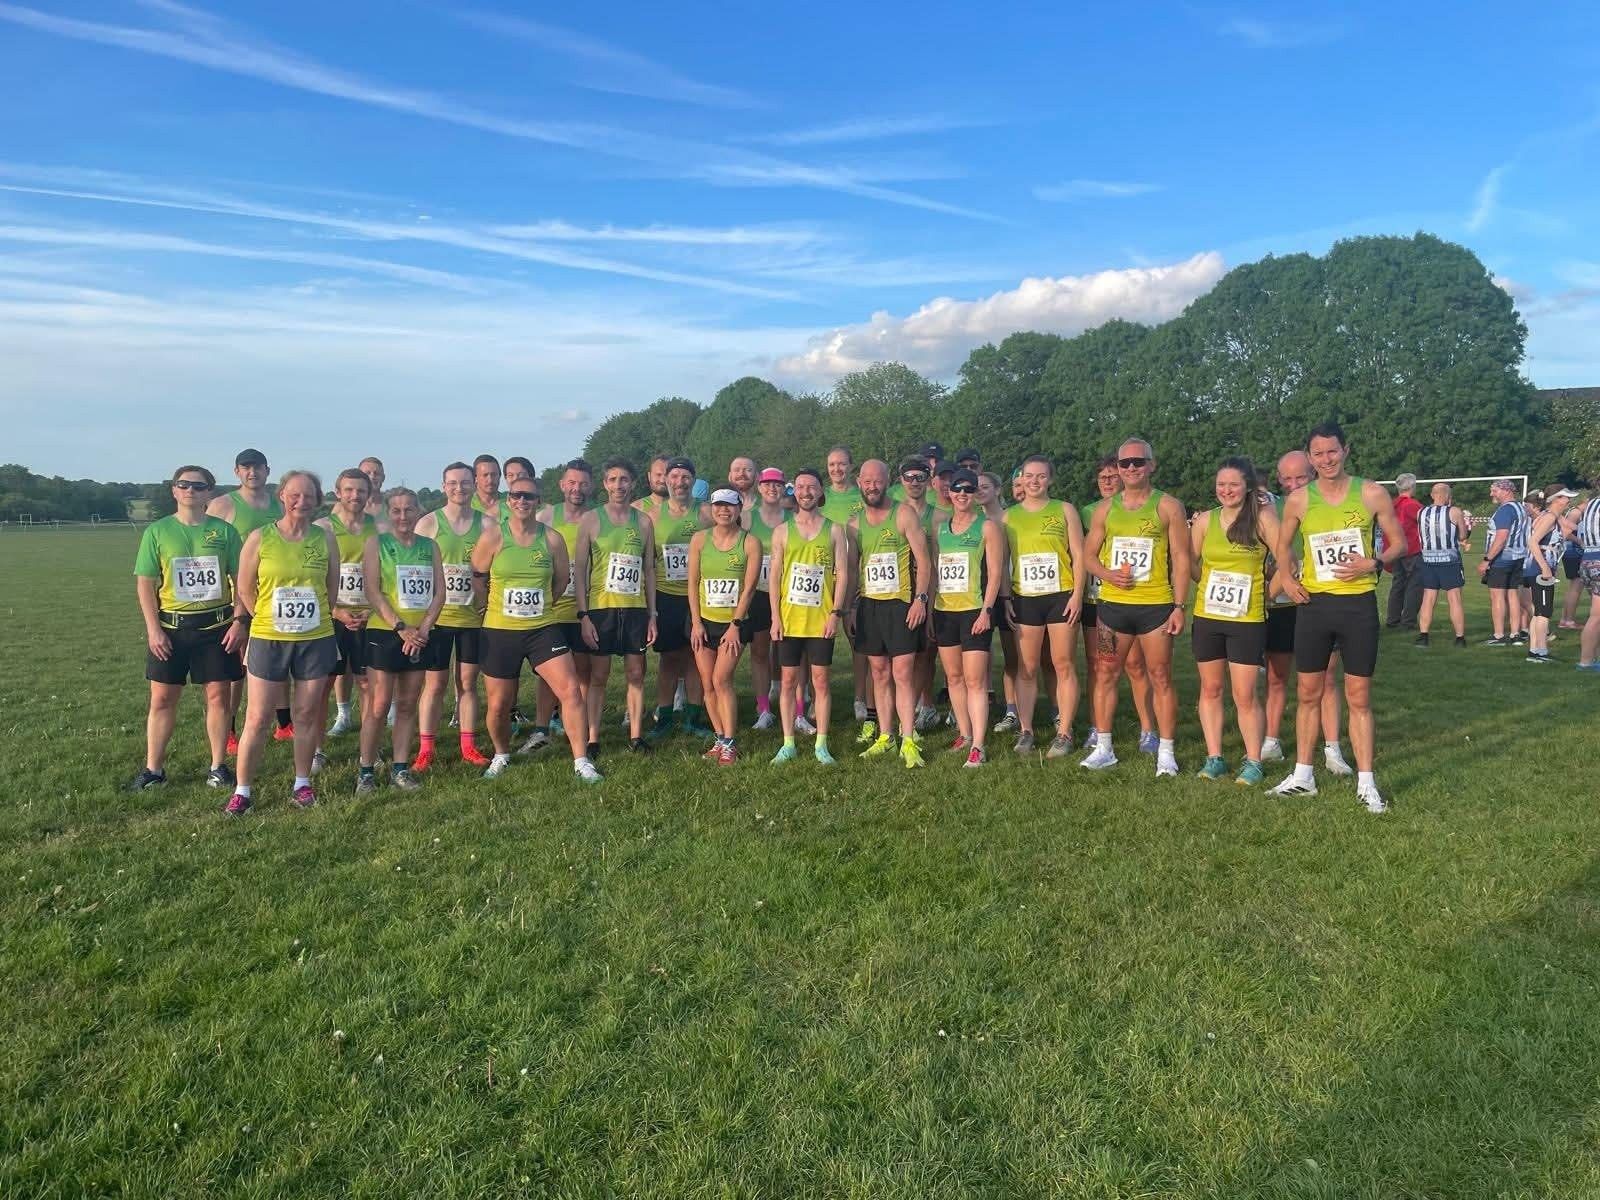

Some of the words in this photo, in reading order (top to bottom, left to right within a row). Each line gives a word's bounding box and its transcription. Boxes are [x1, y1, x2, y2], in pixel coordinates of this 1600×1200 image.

[667, 555, 688, 569] 134
[1115, 550, 1148, 568] 1352
[1317, 544, 1358, 566] 1365
[178, 569, 217, 588] 1348
[611, 565, 640, 584] 1340
[867, 565, 896, 582] 1343
[939, 565, 965, 581] 1332
[1024, 564, 1056, 581] 1356
[340, 575, 364, 592] 134
[402, 578, 431, 595] 1339
[446, 577, 472, 592] 335
[707, 580, 736, 594] 1327
[791, 575, 820, 594] 1336
[508, 590, 541, 606] 1330
[1210, 584, 1244, 605] 1351
[277, 602, 316, 619] 1329
